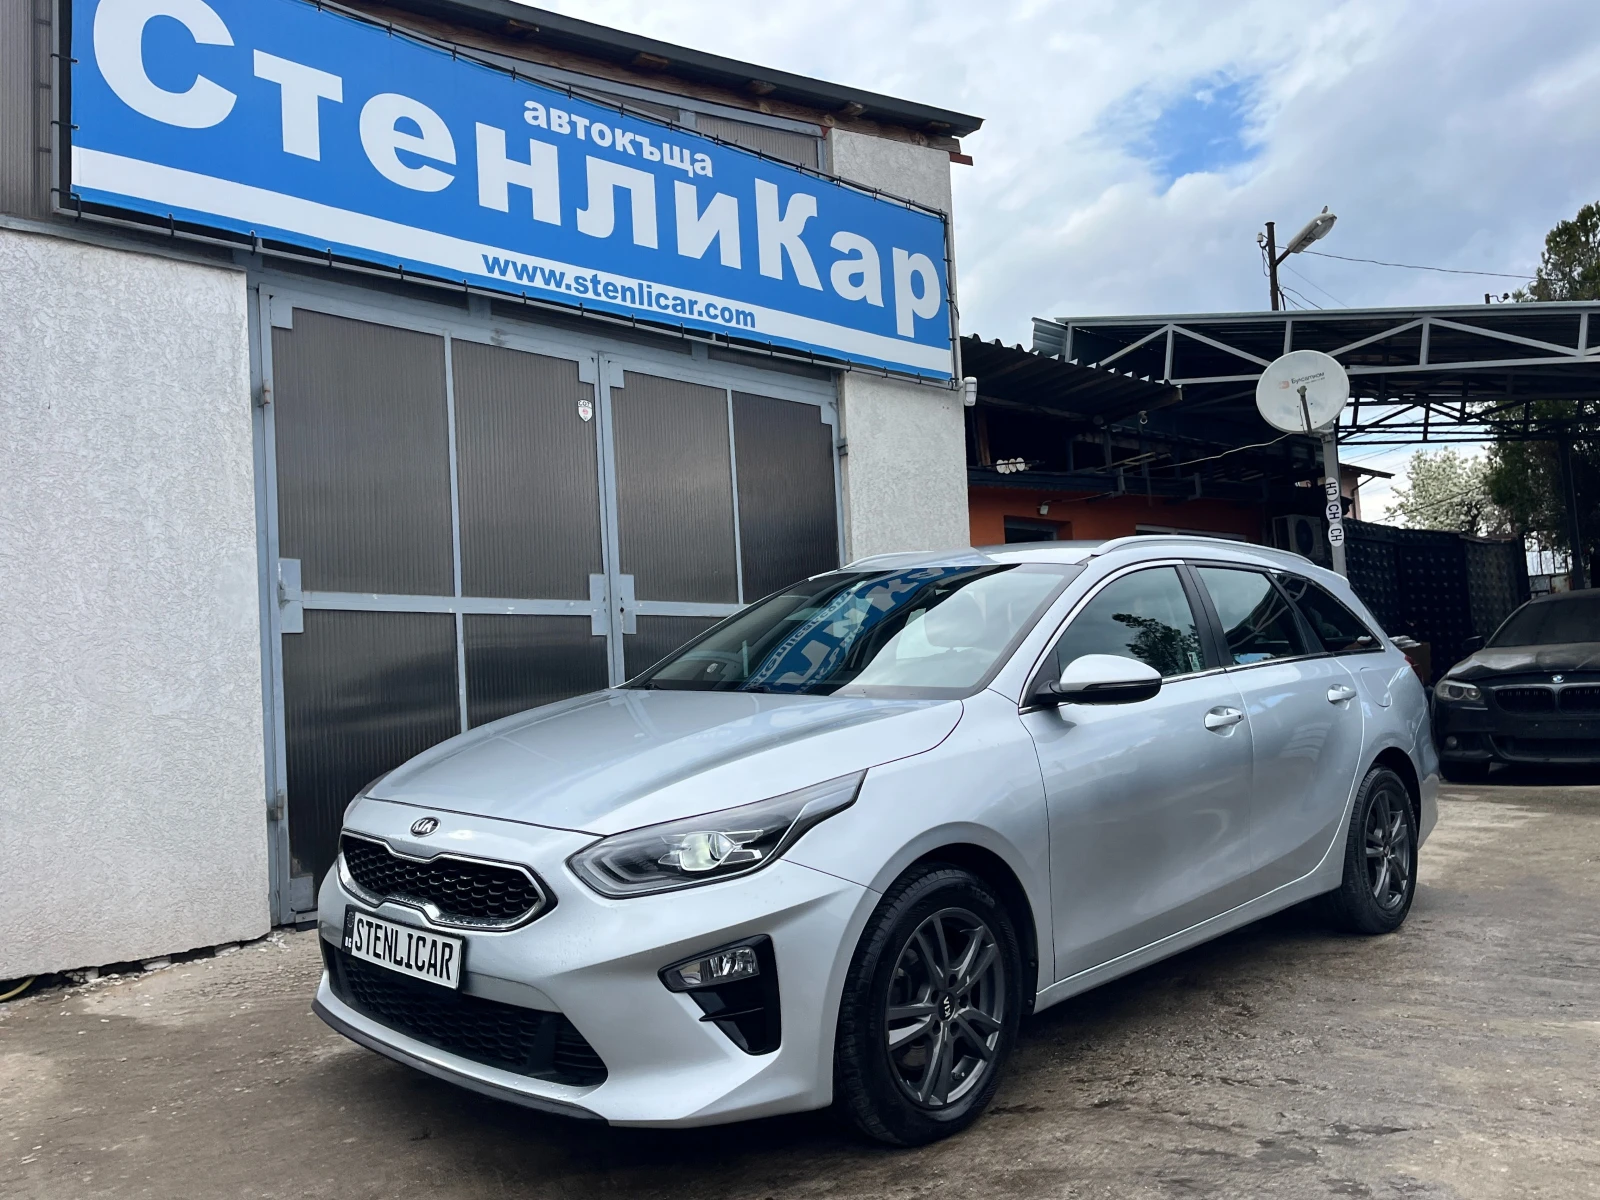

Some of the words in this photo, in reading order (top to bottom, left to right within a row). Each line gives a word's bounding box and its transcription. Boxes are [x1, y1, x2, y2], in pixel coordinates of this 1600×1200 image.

[523, 100, 713, 178] автокъща
[92, 0, 942, 338] СтенлиКар
[481, 253, 756, 329] www.stenlicar.com
[1325, 481, 1338, 496] CH
[1328, 504, 1340, 520] CH
[1330, 528, 1343, 542] CH
[411, 818, 435, 833] KIA
[354, 917, 454, 981] STENLICAR
[943, 996, 951, 1018] KIA
